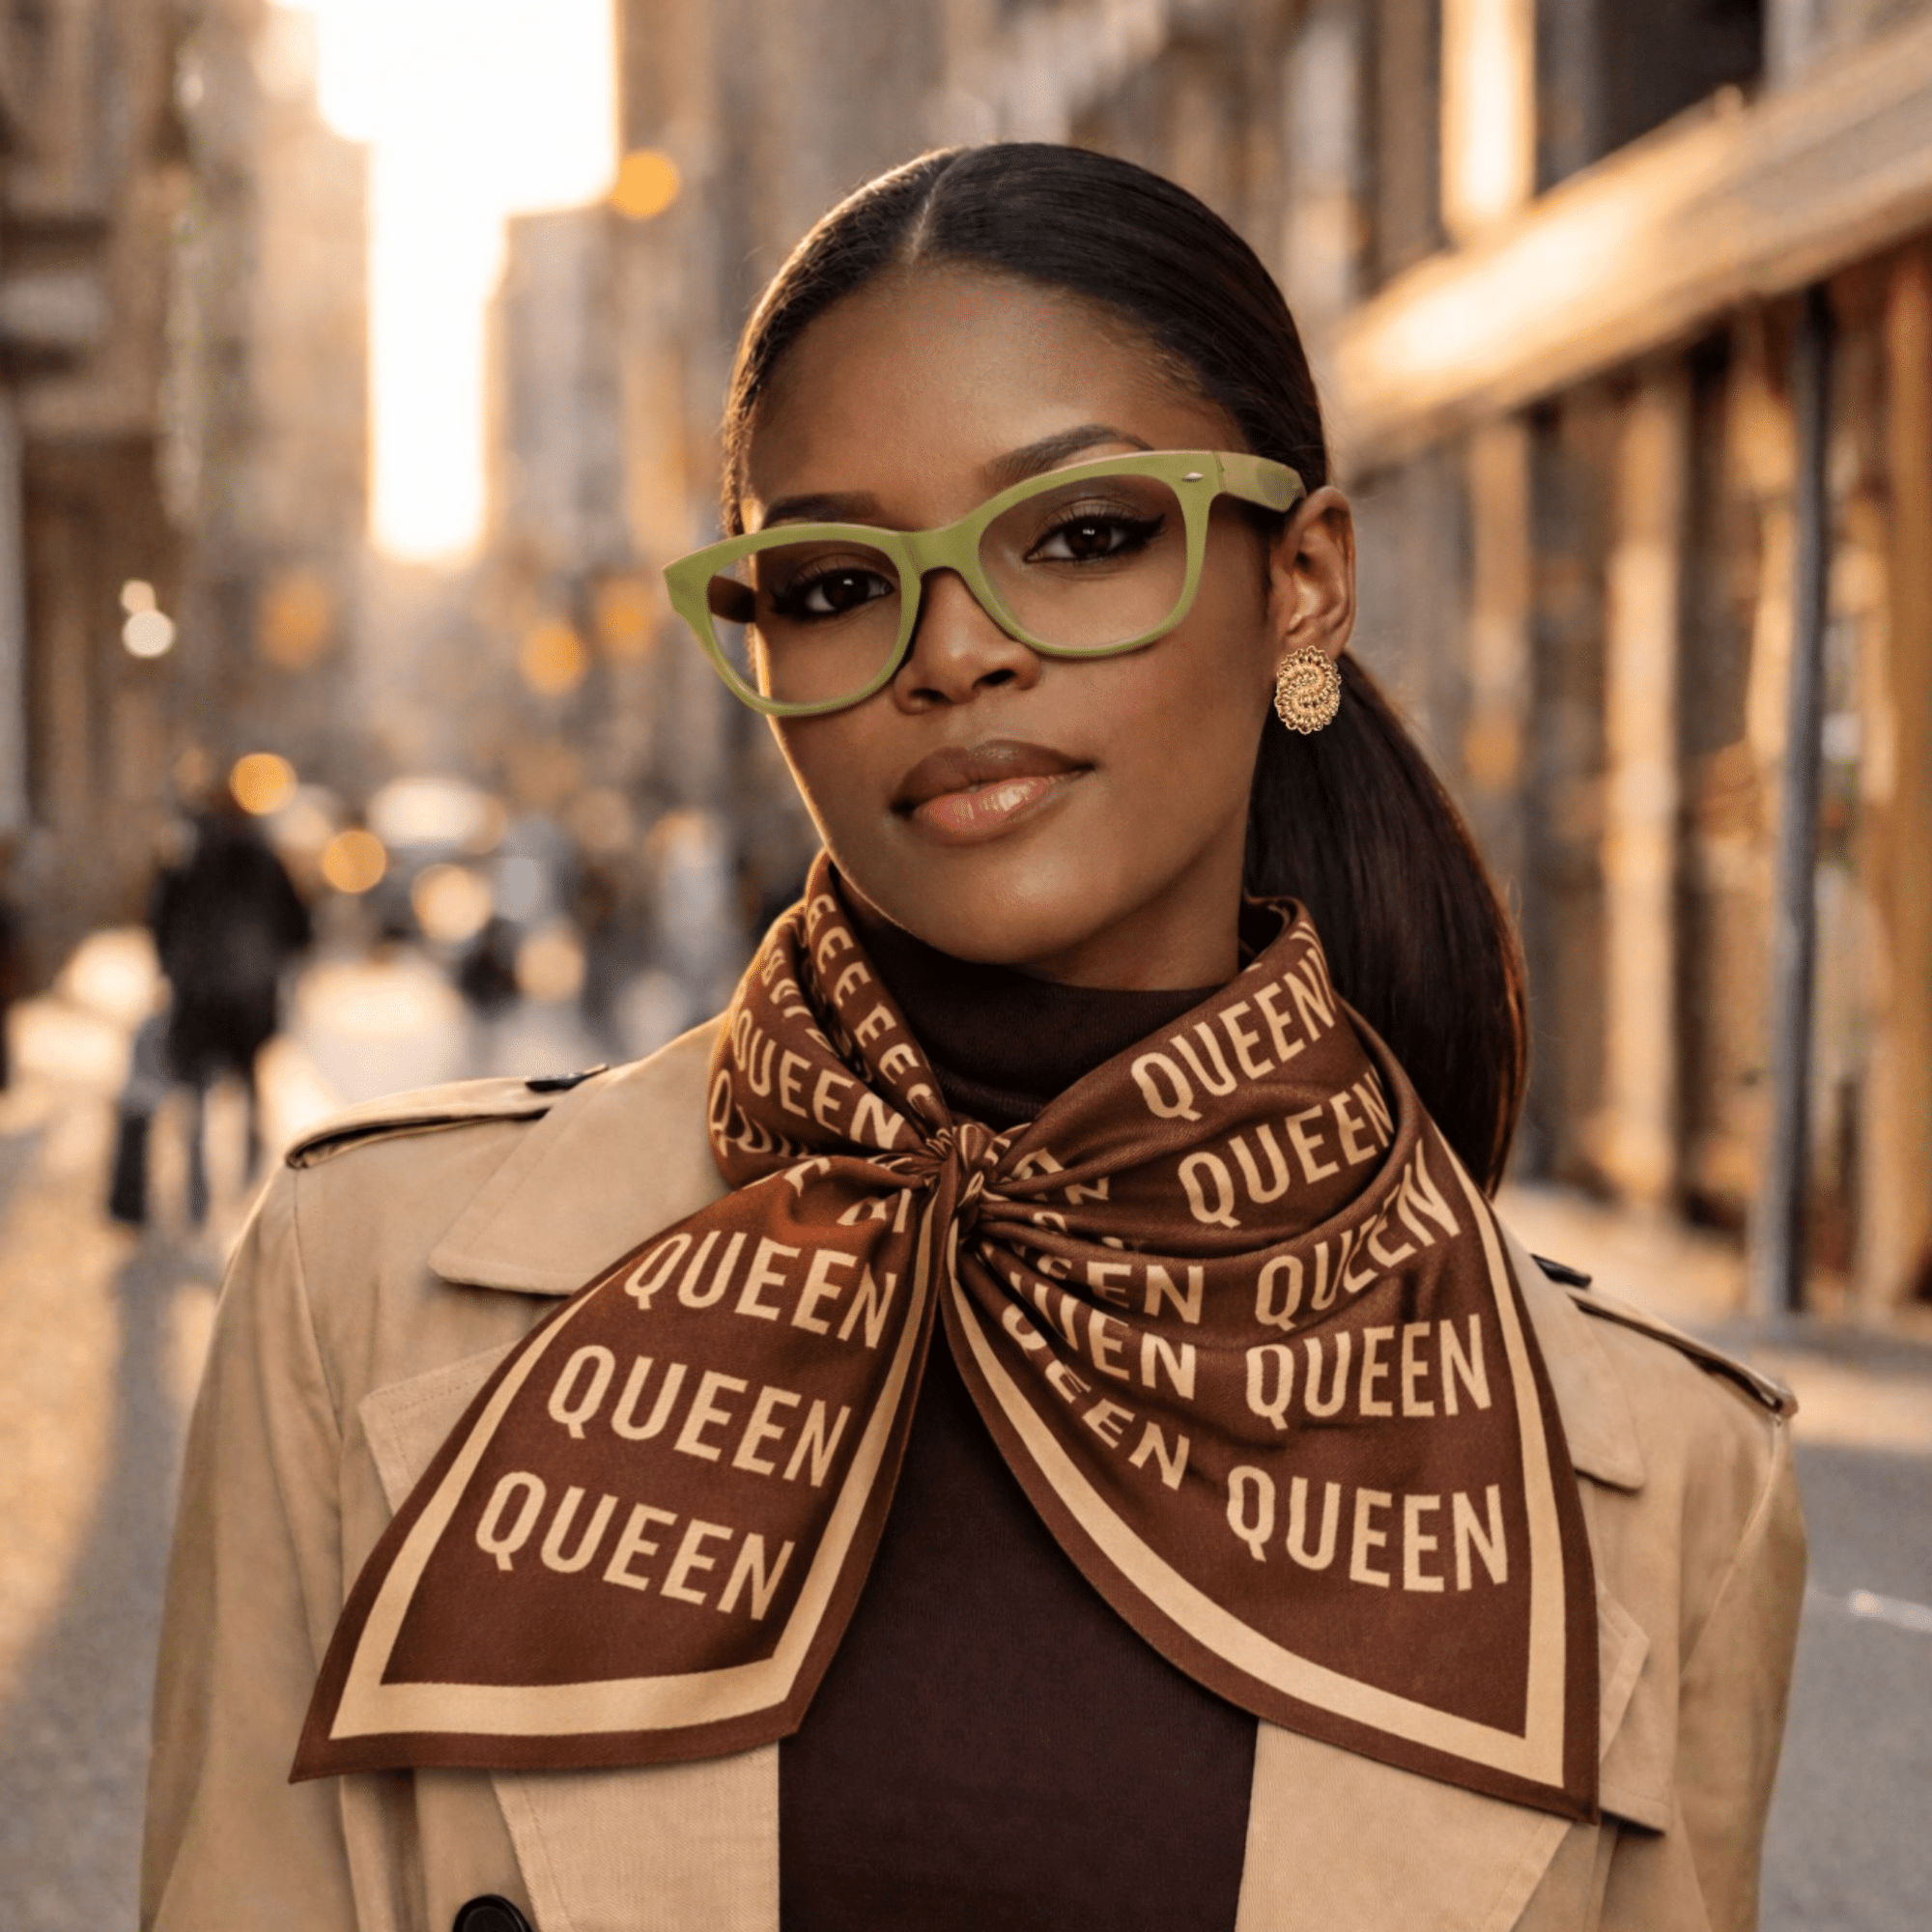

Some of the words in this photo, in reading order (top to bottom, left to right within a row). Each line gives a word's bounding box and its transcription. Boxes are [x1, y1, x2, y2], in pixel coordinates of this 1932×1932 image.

[732, 1009, 905, 1151] QUEEN
[1130, 958, 1335, 1121] QUEEN
[1178, 1071, 1394, 1228] QUEEN
[624, 1230, 897, 1350] QUEEN
[548, 1345, 851, 1488] QUEEN
[1245, 1313, 1492, 1430] QUEEN
[475, 1471, 795, 1621] QUEEN
[1226, 1465, 1508, 1592] QUEEN
